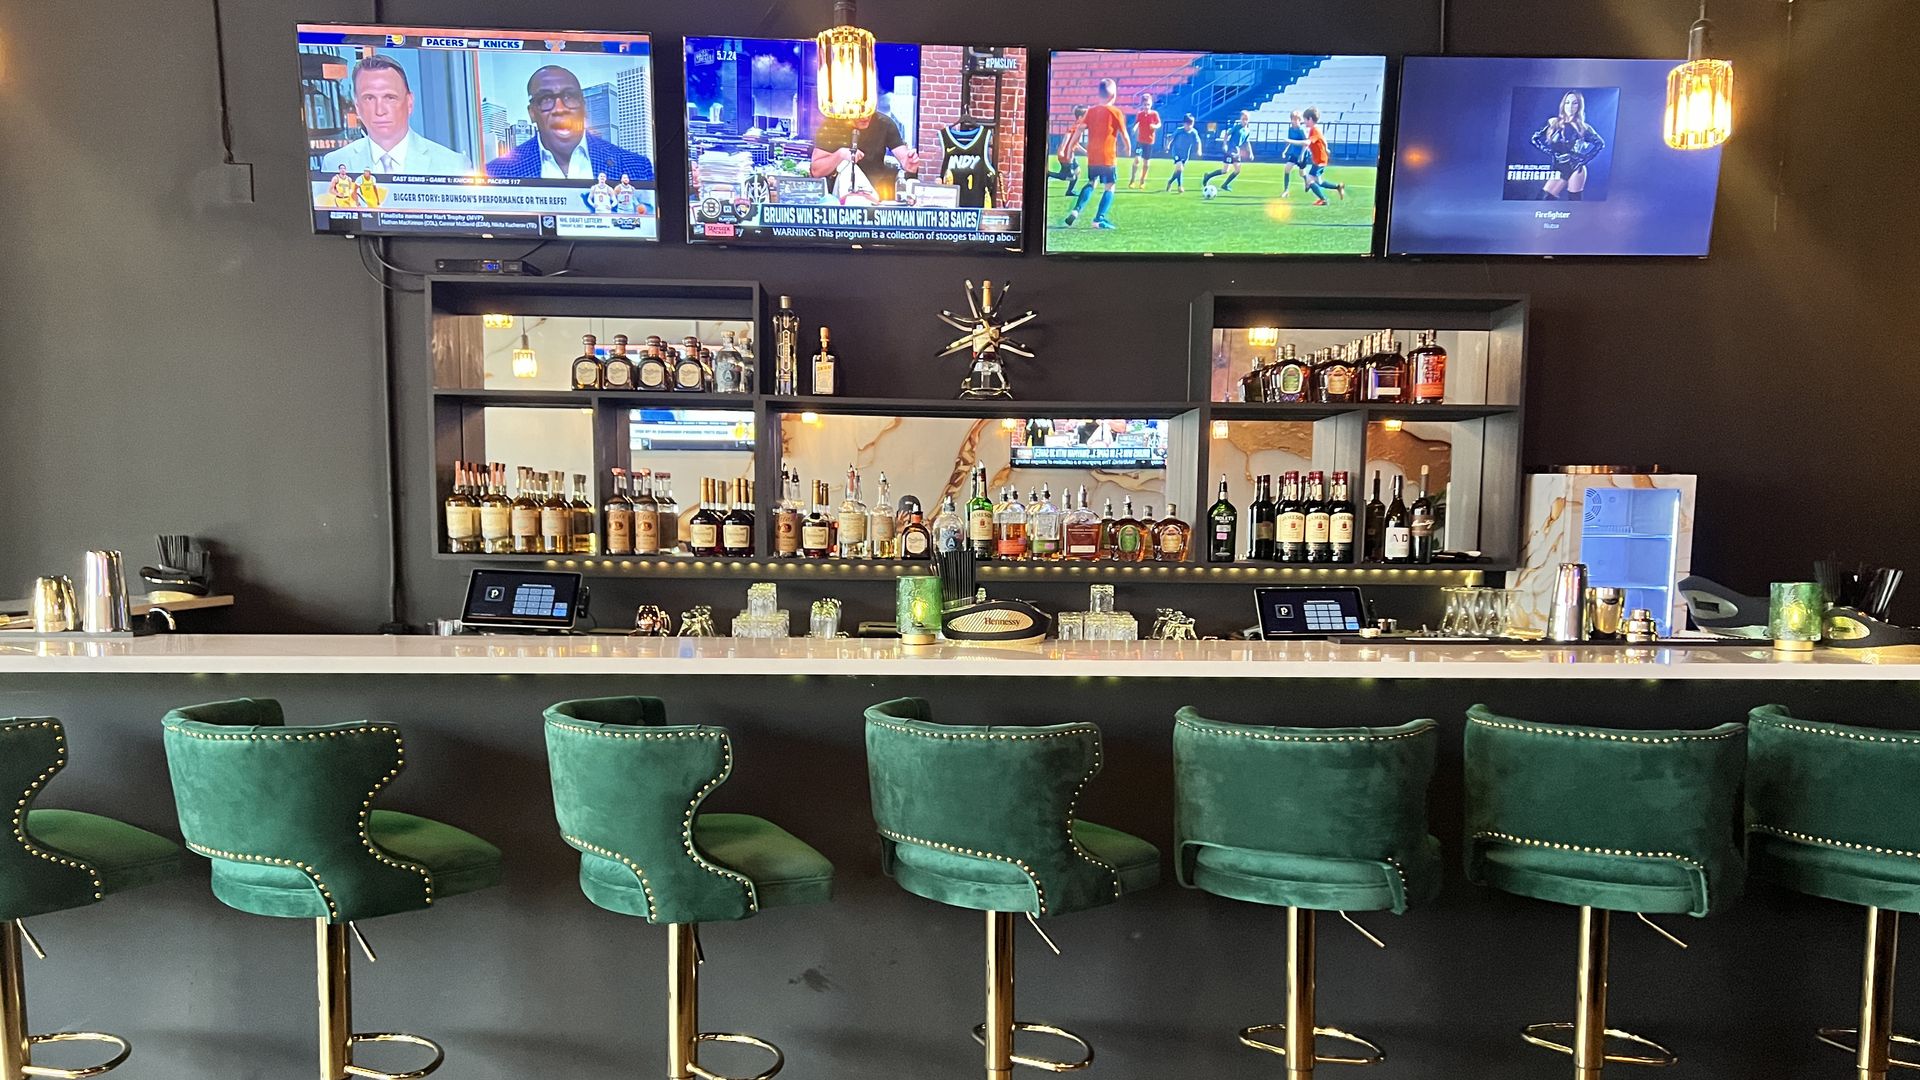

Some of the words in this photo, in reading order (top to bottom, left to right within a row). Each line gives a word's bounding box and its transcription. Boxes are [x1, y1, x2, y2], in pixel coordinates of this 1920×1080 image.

[426, 38, 464, 47] PACERS
[483, 39, 520, 49] KNICKS
[716, 51, 736, 61] 5.7.24
[985, 58, 1017, 69] #PMSLIVE
[310, 139, 336, 149] FIRST
[948, 155, 981, 169] INDY
[1507, 170, 1561, 181] FIREFIGHTER
[967, 174, 973, 190] 1
[393, 193, 417, 201] BIGGER
[418, 193, 441, 203] STORY:
[441, 194, 478, 203] BRUNSON'S
[478, 195, 524, 204] PERFORMANCE
[525, 196, 535, 204] OR
[549, 197, 567, 205] REFS?
[763, 206, 796, 224] BRUINS
[796, 207, 813, 224] WIN
[813, 208, 828, 225] 5-1
[828, 208, 838, 225] IN
[838, 208, 862, 226] GAME
[874, 209, 915, 227] SWAYMAN
[916, 210, 938, 227] WITH
[938, 211, 950, 228] 38
[950, 211, 978, 228] SAVES
[1535, 211, 1571, 220] Firefighter
[772, 227, 816, 237] WARNING:
[817, 229, 834, 238] This
[871, 230, 879, 239] is
[886, 230, 925, 240] collection
[925, 231, 935, 240] of
[935, 232, 967, 243] stooges
[968, 231, 995, 243] talking
[984, 617, 1021, 627] Hennessy
